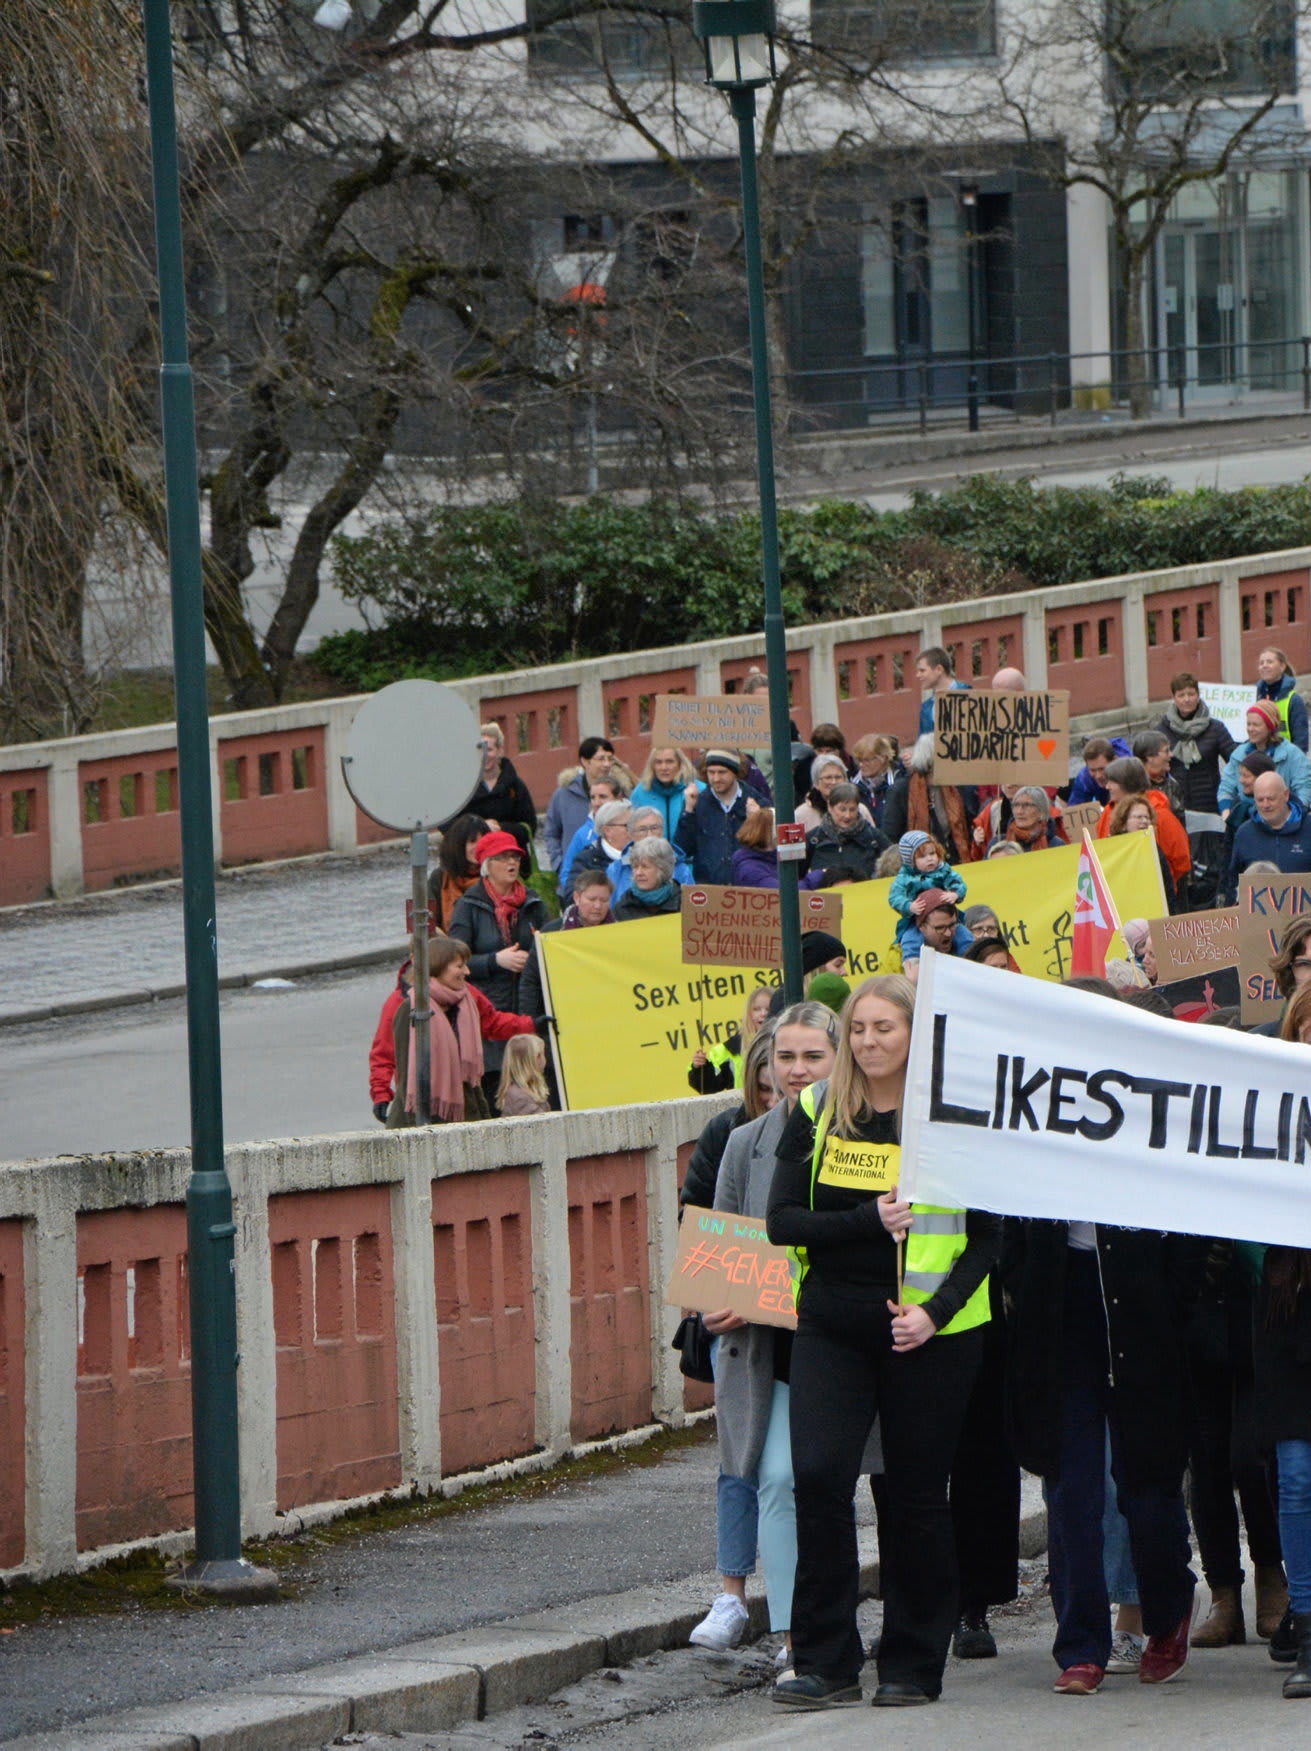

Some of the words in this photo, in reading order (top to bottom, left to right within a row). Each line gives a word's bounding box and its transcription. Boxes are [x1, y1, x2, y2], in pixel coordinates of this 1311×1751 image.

[938, 694, 1061, 734] INTERNASJONAL
[937, 732, 1040, 761] SOLIDARITET
[633, 984, 680, 1011] Sex
[688, 973, 745, 1002] uten
[666, 1022, 688, 1051] vi
[834, 1149, 889, 1168] AMNESTY
[699, 1216, 726, 1235] UN
